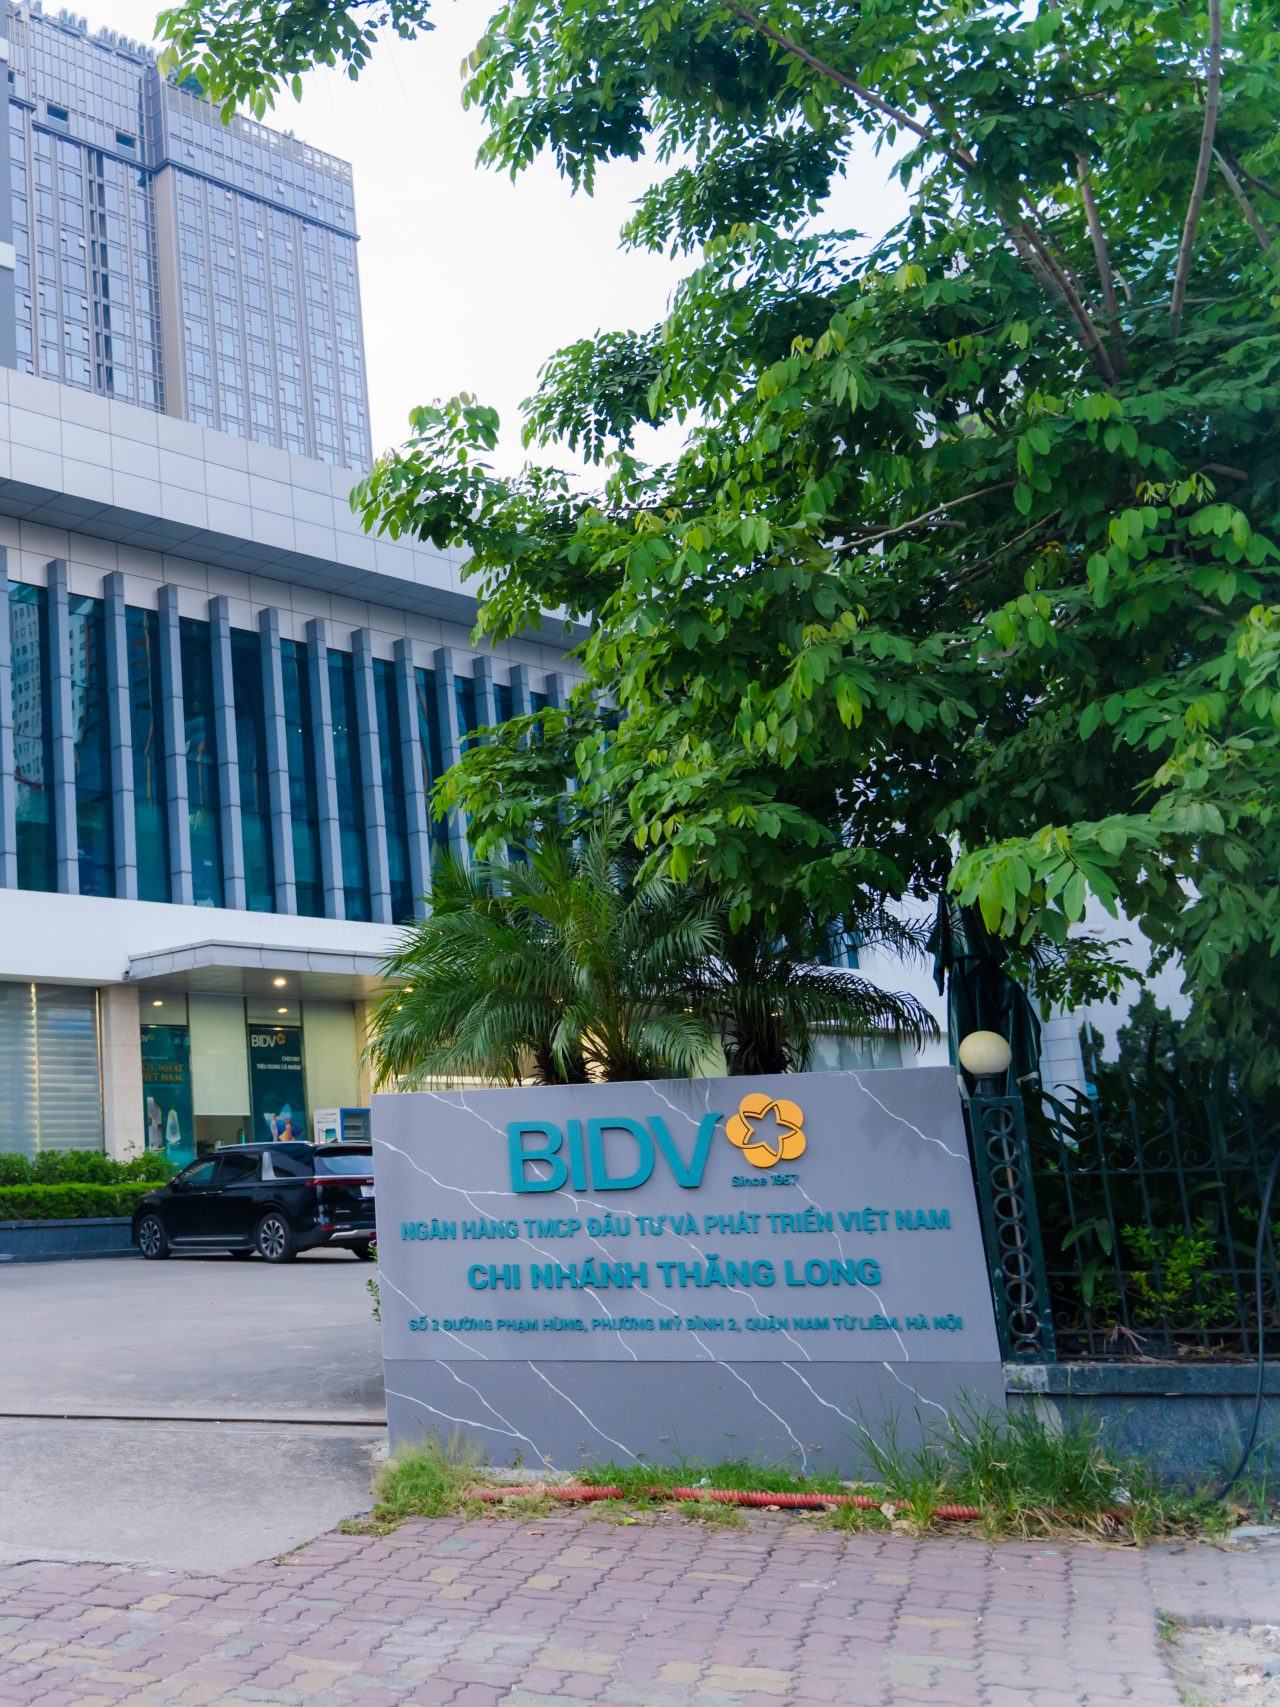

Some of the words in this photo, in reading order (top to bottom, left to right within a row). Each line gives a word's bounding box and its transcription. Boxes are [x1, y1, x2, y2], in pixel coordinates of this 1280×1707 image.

[251, 1034, 276, 1047] BIDV
[506, 1112, 723, 1193] BIDV
[731, 1174, 767, 1187] Since
[769, 1173, 799, 1186] 1957
[400, 1218, 457, 1241] NGÂN
[462, 1217, 519, 1240] HÀNG
[523, 1218, 582, 1239] TMCP
[586, 1211, 630, 1237] ĐẦU
[635, 1214, 666, 1236] TƯ
[669, 1211, 700, 1236] VÀ
[703, 1209, 761, 1235] PHÁT
[769, 1205, 834, 1233] TRIỂN
[838, 1207, 889, 1235] VIỆT
[895, 1208, 952, 1231] NAM
[467, 1262, 521, 1290] CHI
[530, 1256, 649, 1290] NHÁNH
[656, 1253, 776, 1289] THĂNG
[784, 1257, 882, 1288] LONG
[408, 1314, 428, 1332] SỐ
[442, 1315, 493, 1332] ĐƯỜNG
[496, 1317, 539, 1334] PHẠM
[541, 1315, 589, 1333] HÙNG,
[591, 1315, 655, 1332] PHƯỜNG
[658, 1315, 683, 1332] MỸ
[686, 1314, 725, 1331] ĐÌNH
[727, 1317, 742, 1333] 2,
[745, 1314, 789, 1334] QUẬN
[793, 1316, 830, 1331] NAM
[833, 1313, 859, 1331] TỪ
[905, 1313, 931, 1331] HÀ
[933, 1313, 964, 1333] NỘI
